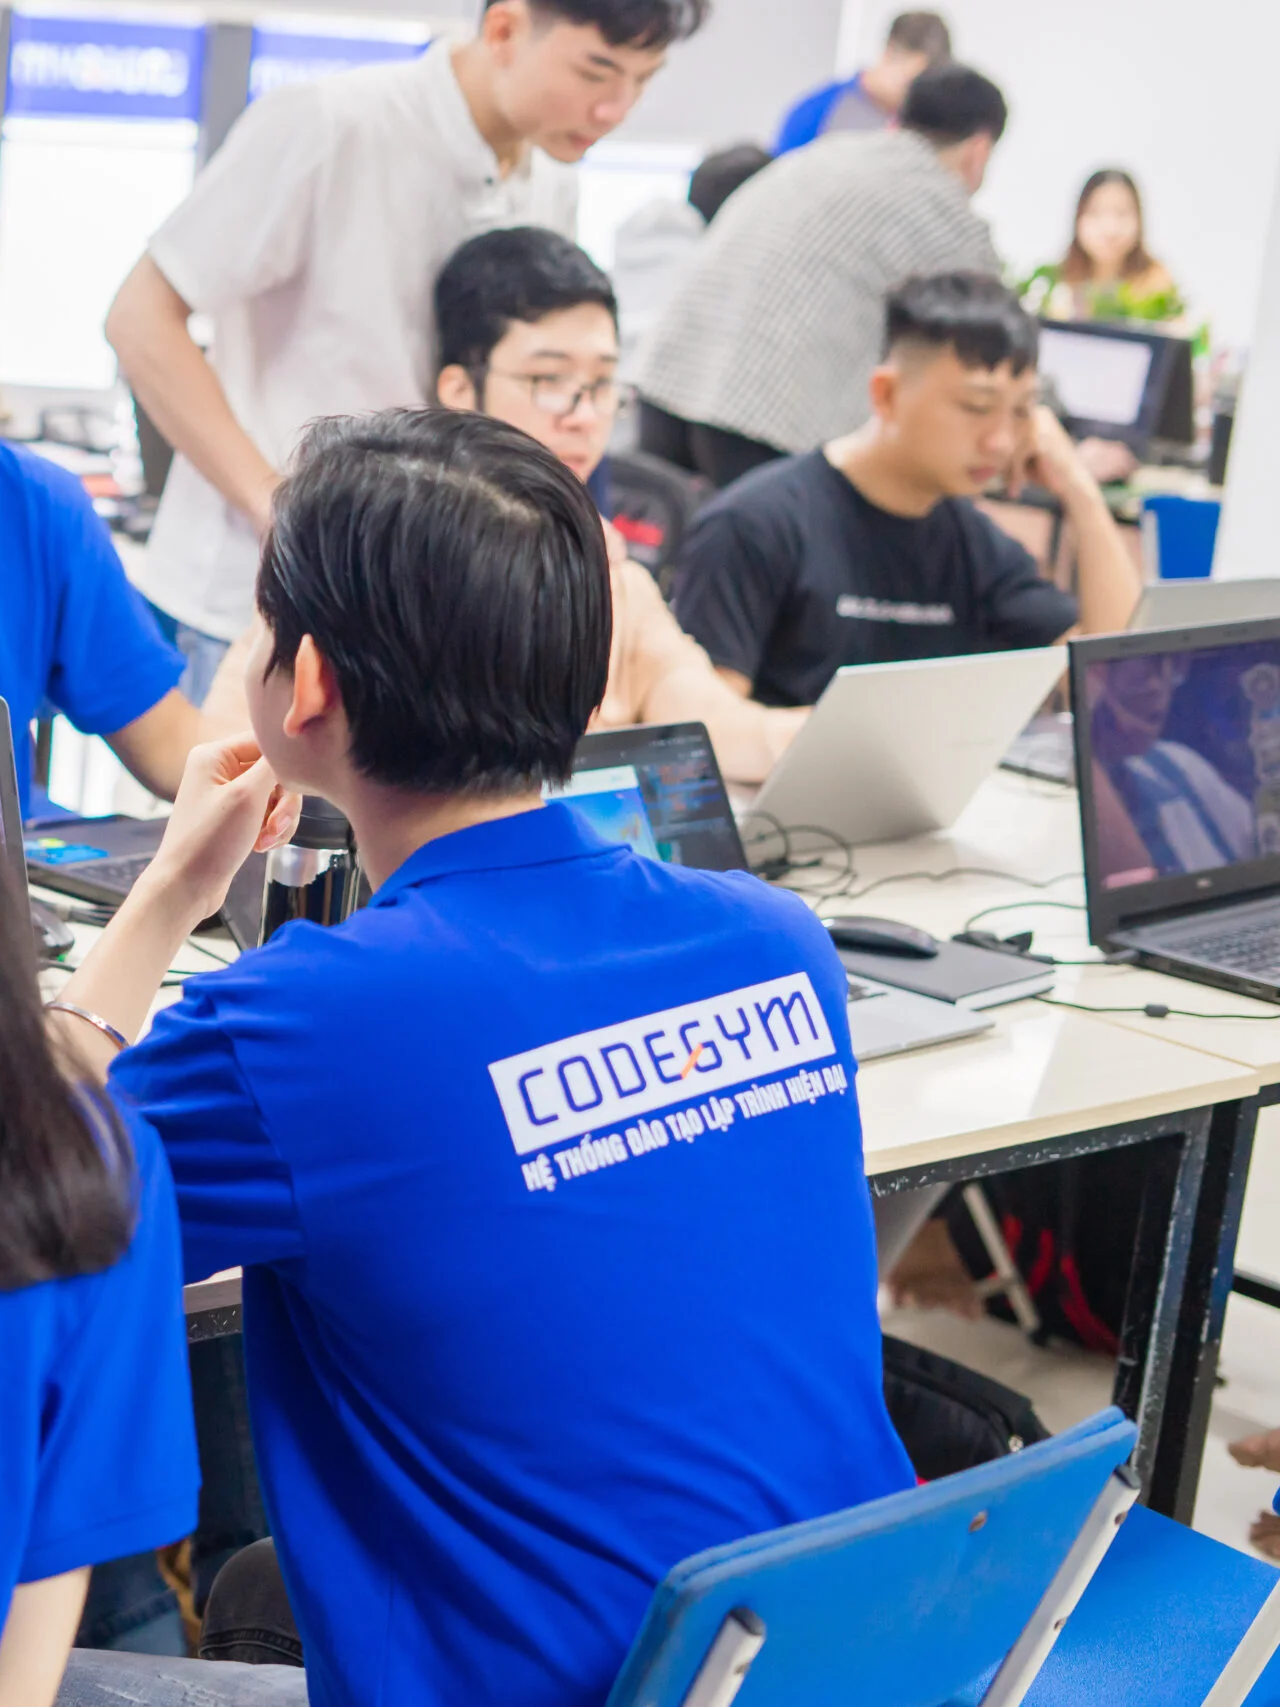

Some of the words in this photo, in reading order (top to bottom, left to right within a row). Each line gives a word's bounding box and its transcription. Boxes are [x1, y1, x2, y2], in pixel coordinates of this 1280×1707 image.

[517, 990, 820, 1127] CODEGYM
[521, 1153, 557, 1192] HỆ
[553, 1133, 629, 1180] THỐNG
[625, 1118, 669, 1156] ĐÀO
[665, 1108, 704, 1143] TẠO
[700, 1096, 735, 1132] LẬP
[734, 1083, 790, 1119] TRÌNH
[785, 1069, 826, 1104] HIỆN
